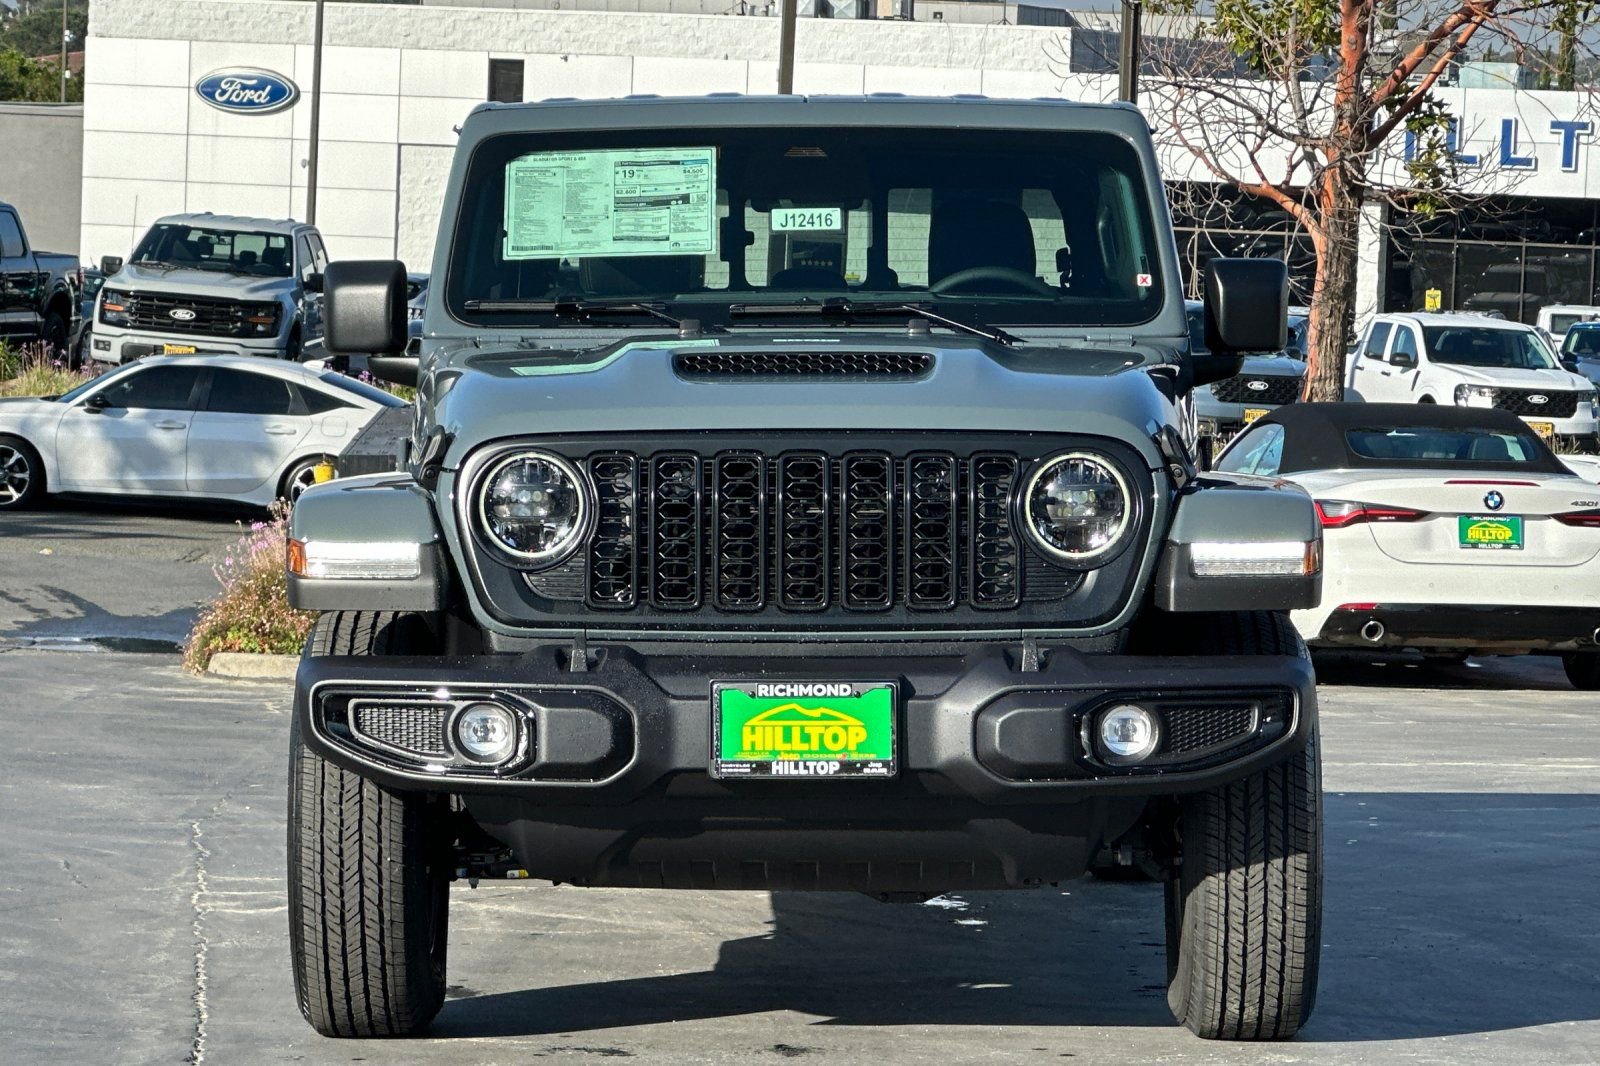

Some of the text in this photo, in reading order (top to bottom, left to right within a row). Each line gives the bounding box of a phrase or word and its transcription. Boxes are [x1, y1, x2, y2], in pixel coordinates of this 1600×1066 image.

[214, 77, 271, 103] Ford
[621, 169, 635, 179] 19
[780, 213, 833, 228] J12416
[1467, 528, 1513, 540] HILLTOP
[757, 684, 852, 697] RICHMOND
[742, 725, 868, 752] HILLTOP
[771, 760, 840, 775] HILLTOP
